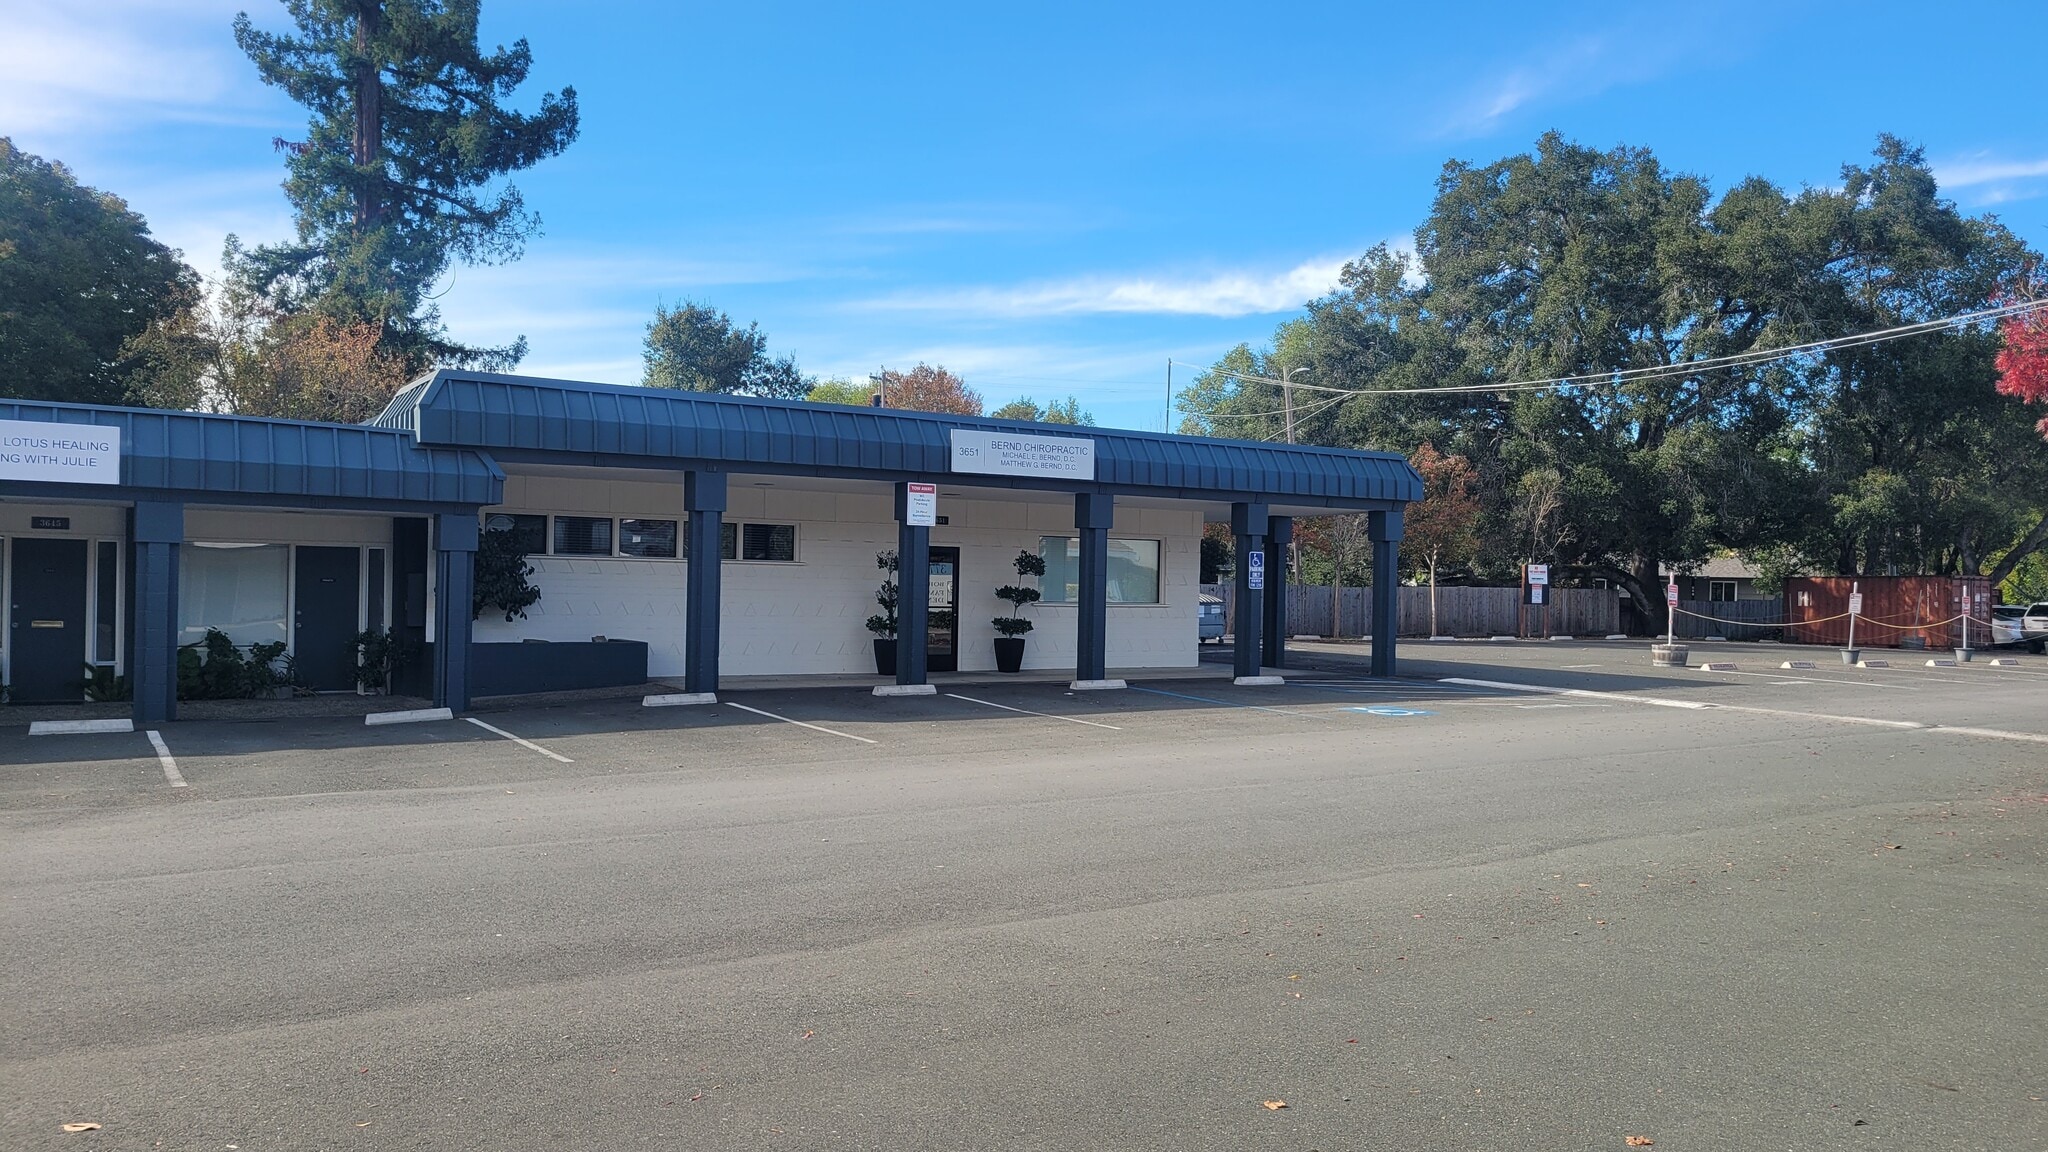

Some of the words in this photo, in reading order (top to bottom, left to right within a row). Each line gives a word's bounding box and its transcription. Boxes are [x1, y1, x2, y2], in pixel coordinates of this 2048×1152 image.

[3, 437, 48, 448] LOTUS
[52, 439, 110, 452] HEALING
[991, 441, 1022, 451] BERND
[1024, 443, 1089, 456] CHIROPRACTIC
[959, 447, 979, 457] 3651
[1002, 451, 1031, 460] MICHAEL
[1039, 454, 1062, 462] BERND,
[1063, 455, 1076, 463] D.C.
[24, 454, 58, 465] WITH
[62, 456, 97, 467] JULIE
[1000, 460, 1031, 468] MATTHEW
[1040, 462, 1064, 470] BERND,
